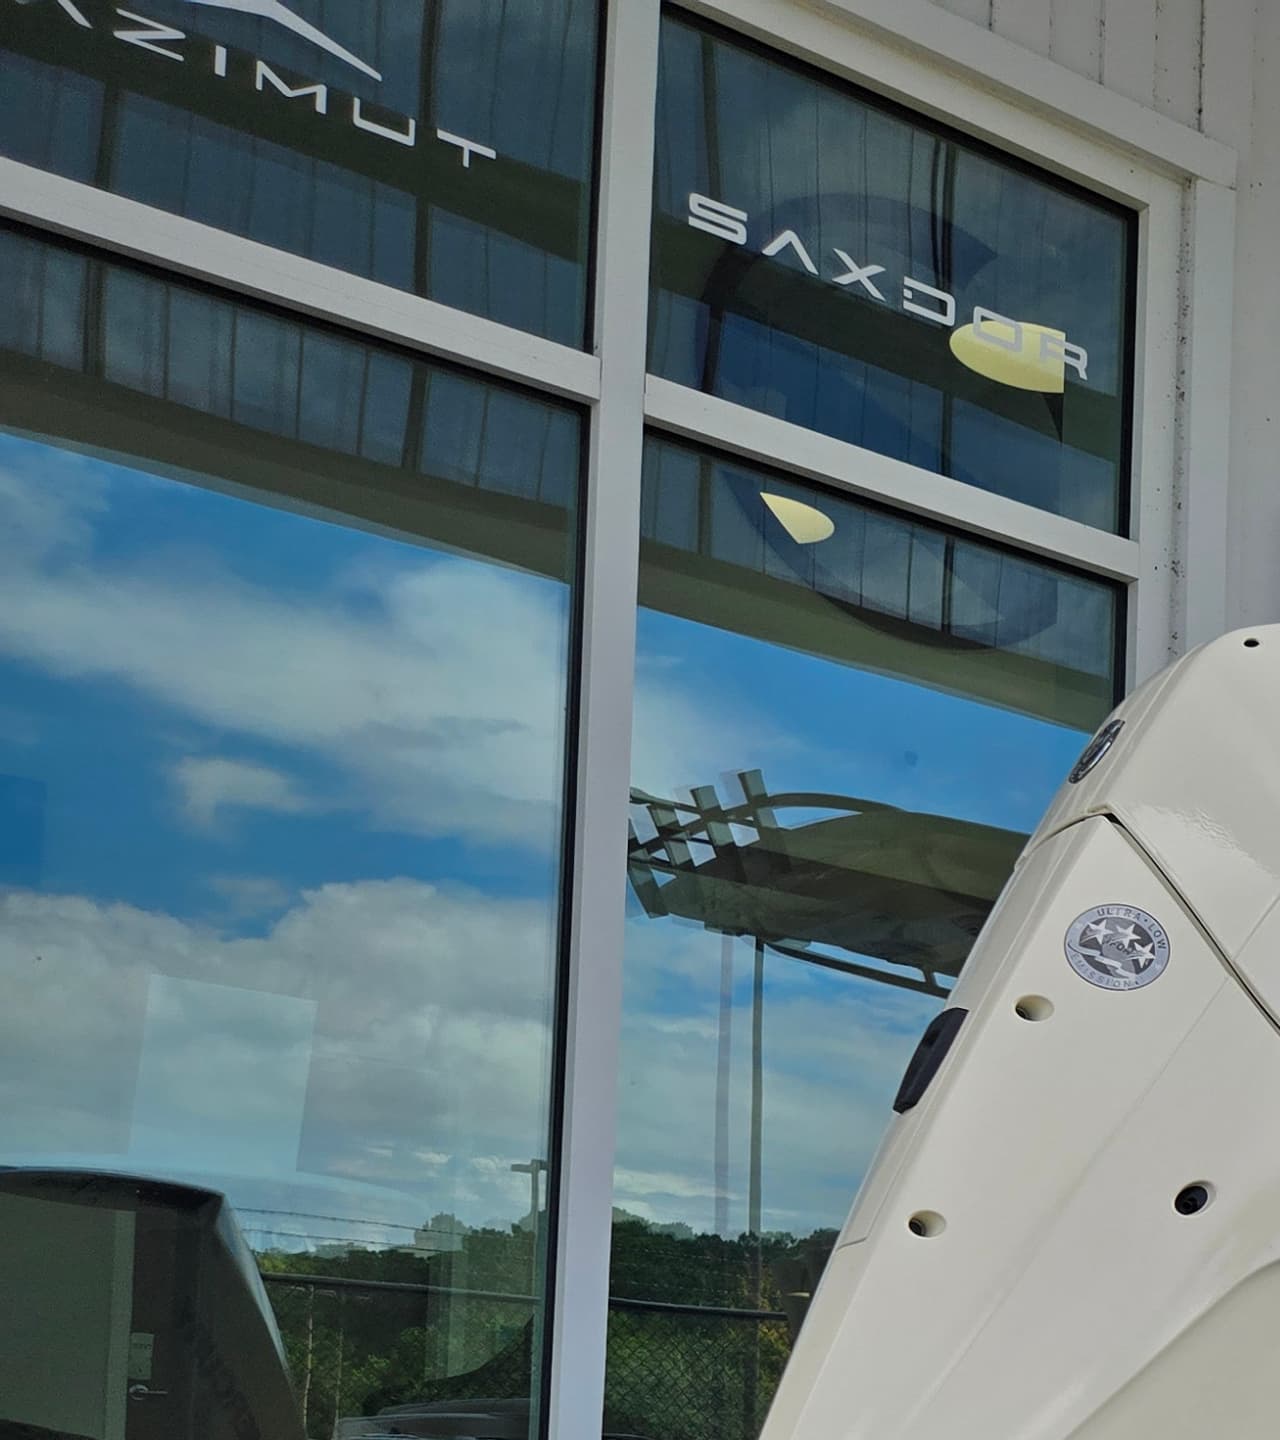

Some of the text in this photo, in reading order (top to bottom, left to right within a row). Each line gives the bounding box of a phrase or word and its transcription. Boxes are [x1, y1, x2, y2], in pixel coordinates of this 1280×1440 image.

[689, 193, 1089, 381] SAXDOR
[1097, 906, 1141, 921] ULTRA
[1149, 923, 1167, 950] LOW
